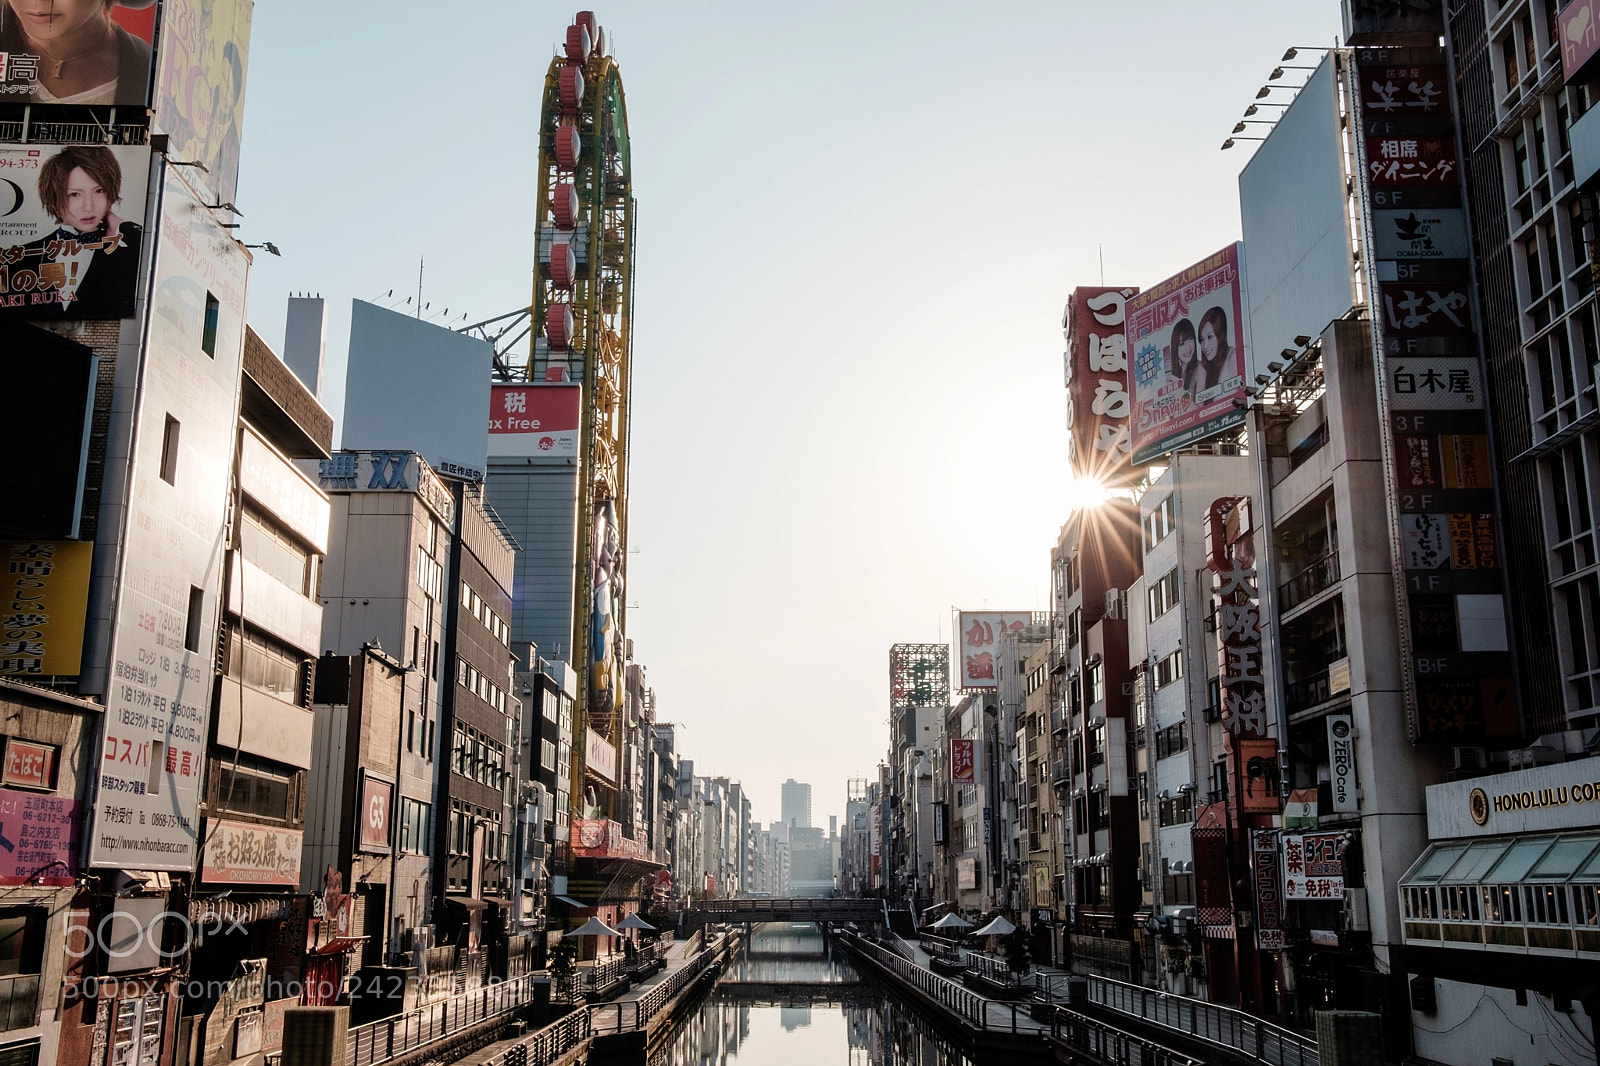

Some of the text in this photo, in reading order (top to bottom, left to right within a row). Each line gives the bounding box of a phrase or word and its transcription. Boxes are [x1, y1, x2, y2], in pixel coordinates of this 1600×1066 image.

[0, 52, 40, 82] 高
[0, 84, 39, 94] トクラブ
[1366, 80, 1442, 112] 笑笑
[1381, 140, 1418, 158] 相席
[1370, 160, 1455, 182] ダイニング
[31, 291, 79, 305] RUKA
[1184, 267, 1237, 305] お仕事探し
[1134, 292, 1189, 341] 高収入
[1394, 365, 1474, 394] 白木屋
[505, 392, 527, 413] 税
[508, 416, 541, 430] Free
[0, 543, 55, 674] 素晴らしい夢の実現
[139, 648, 157, 666] ロッジ
[1213, 560, 1267, 737] 大阪王将
[153, 694, 167, 712] 平日
[151, 716, 165, 734] 平日
[8, 751, 44, 777] たばこ
[104, 736, 200, 778] コスパ 最高!
[962, 741, 972, 767] ツルハ
[1334, 740, 1348, 776] ZERO
[369, 794, 385, 830] G3
[1494, 786, 1569, 814] HONOLULU
[104, 805, 133, 825] 予約受付
[100, 833, 189, 854] http://www.nihonbaracc.com
[1286, 838, 1303, 875] 薬
[230, 870, 273, 881] OKONOMIYAKI
[1259, 852, 1276, 902] ダイコク
[1306, 879, 1331, 898] 免税
